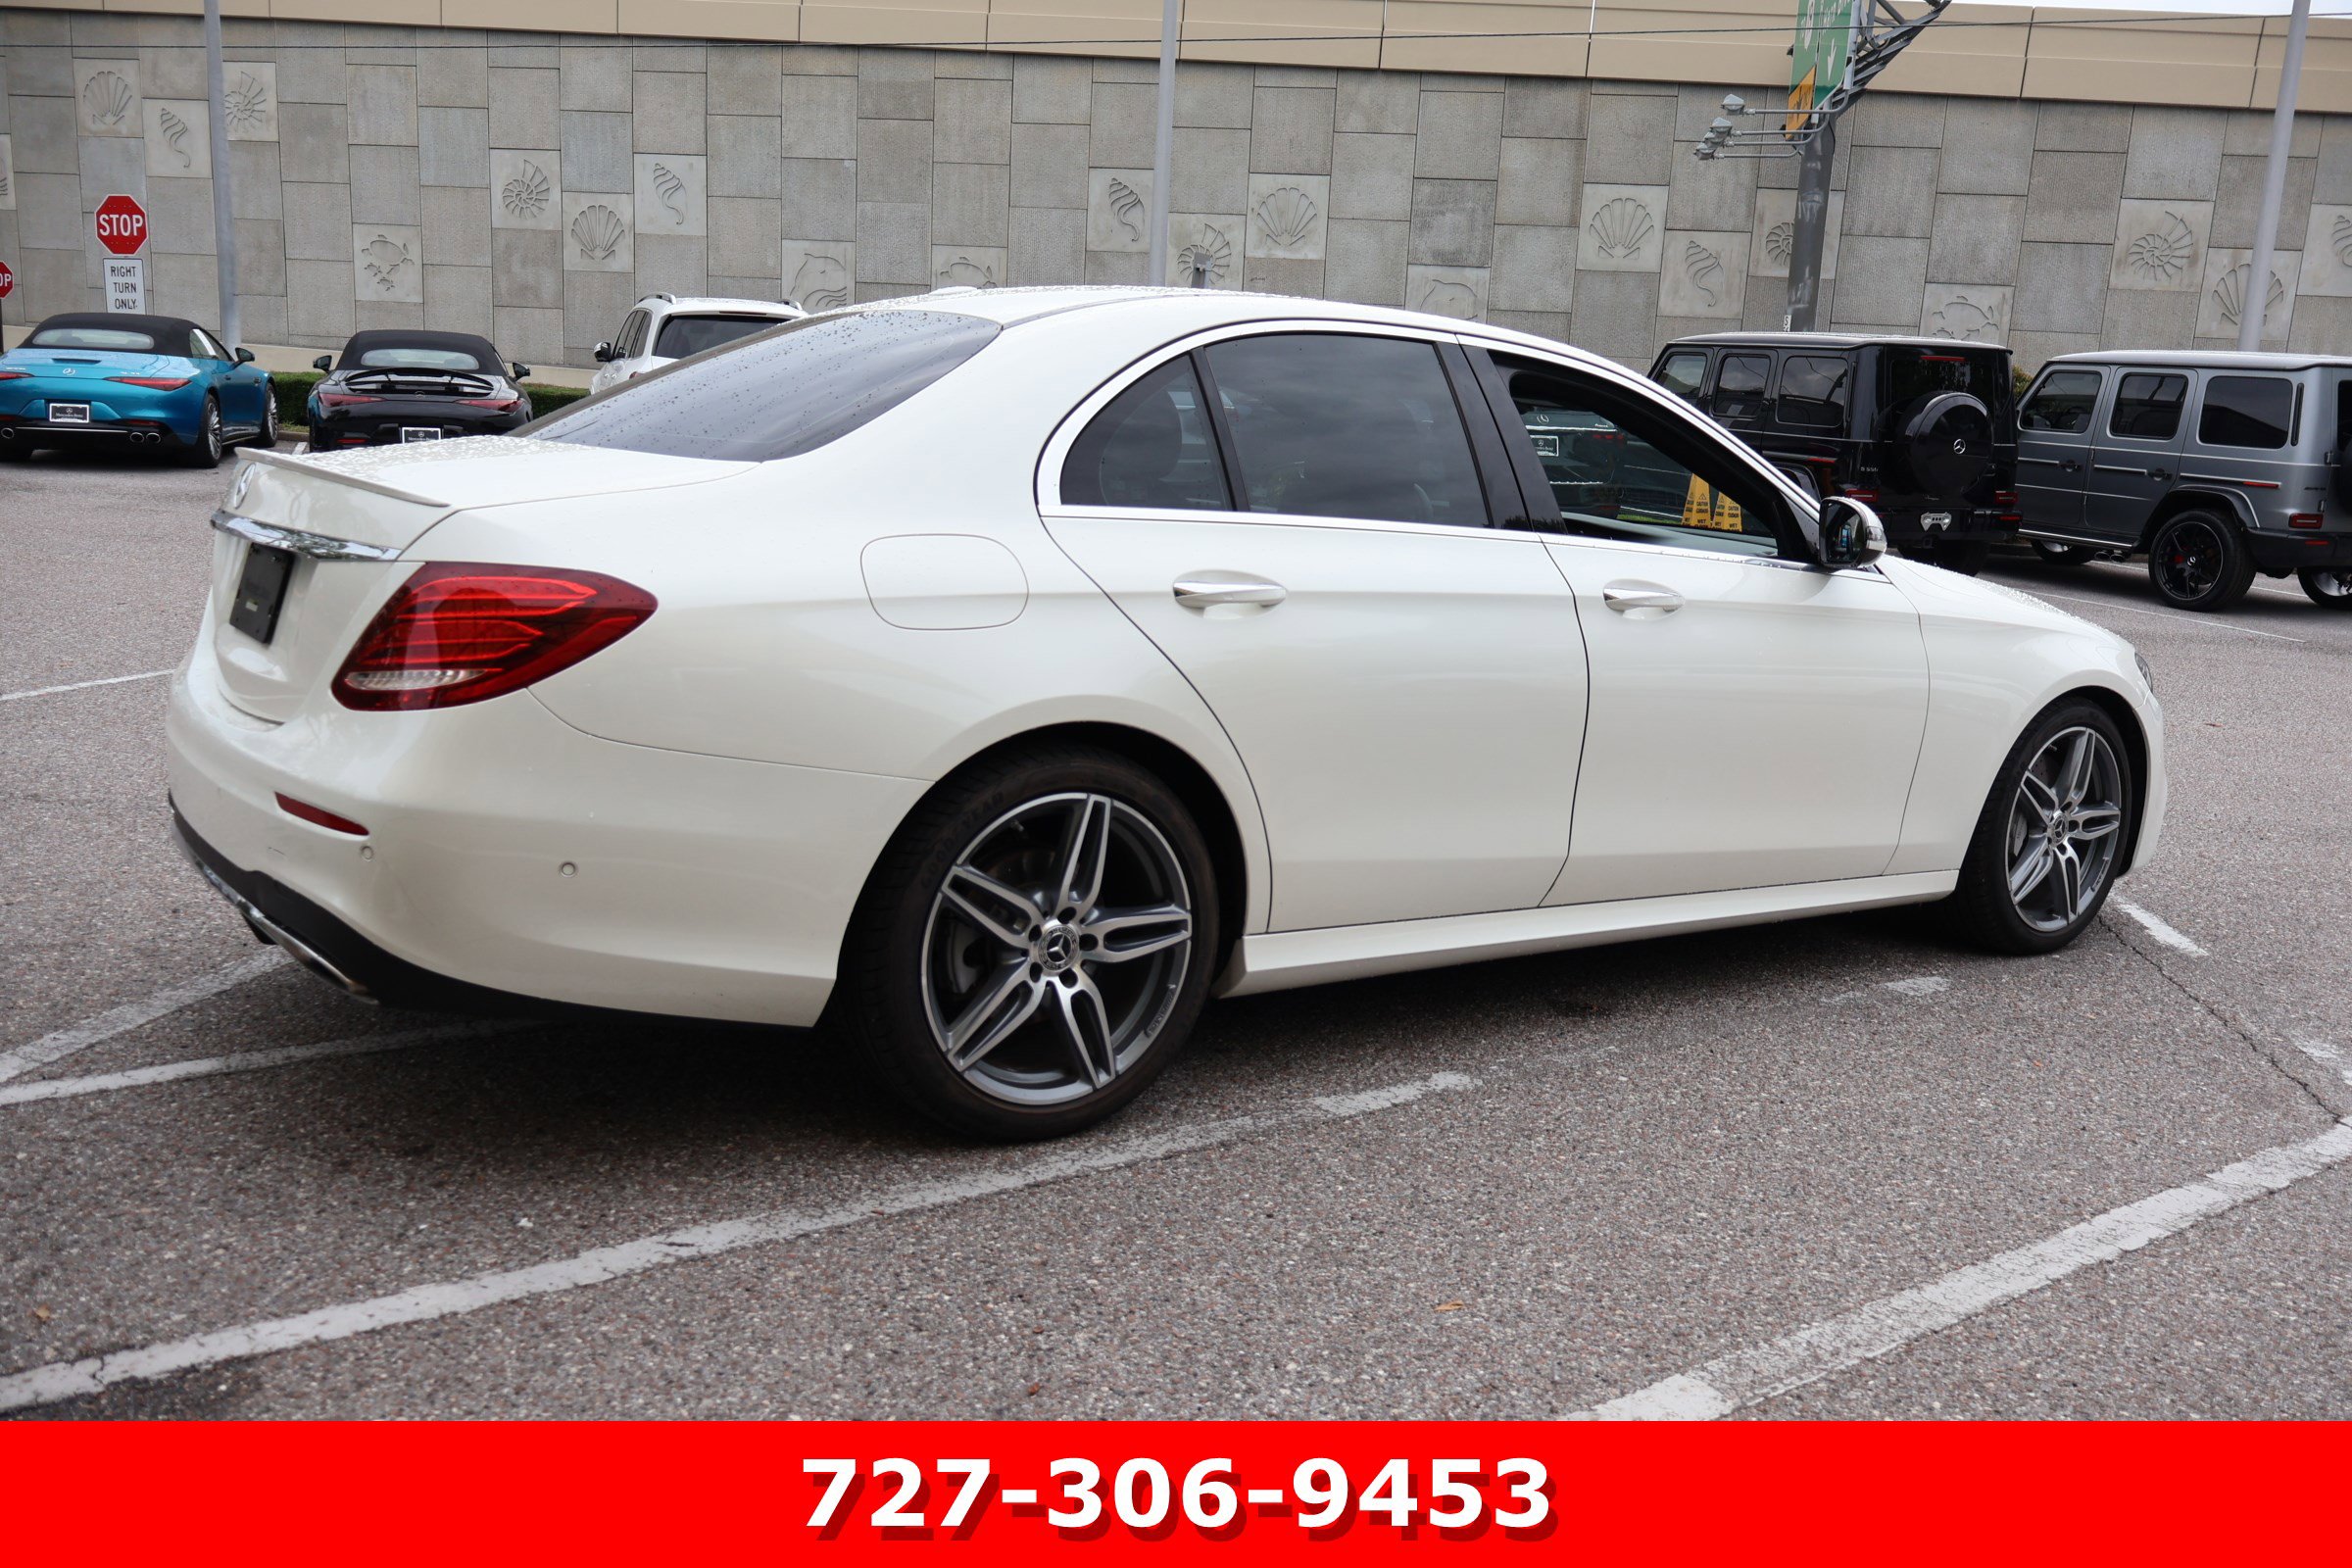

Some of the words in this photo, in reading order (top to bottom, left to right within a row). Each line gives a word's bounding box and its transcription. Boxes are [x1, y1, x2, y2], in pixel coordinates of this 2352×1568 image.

[99, 214, 143, 236] STOP
[110, 266, 136, 277] RIGHT
[113, 281, 136, 293] TURN
[115, 298, 137, 310] ONLY
